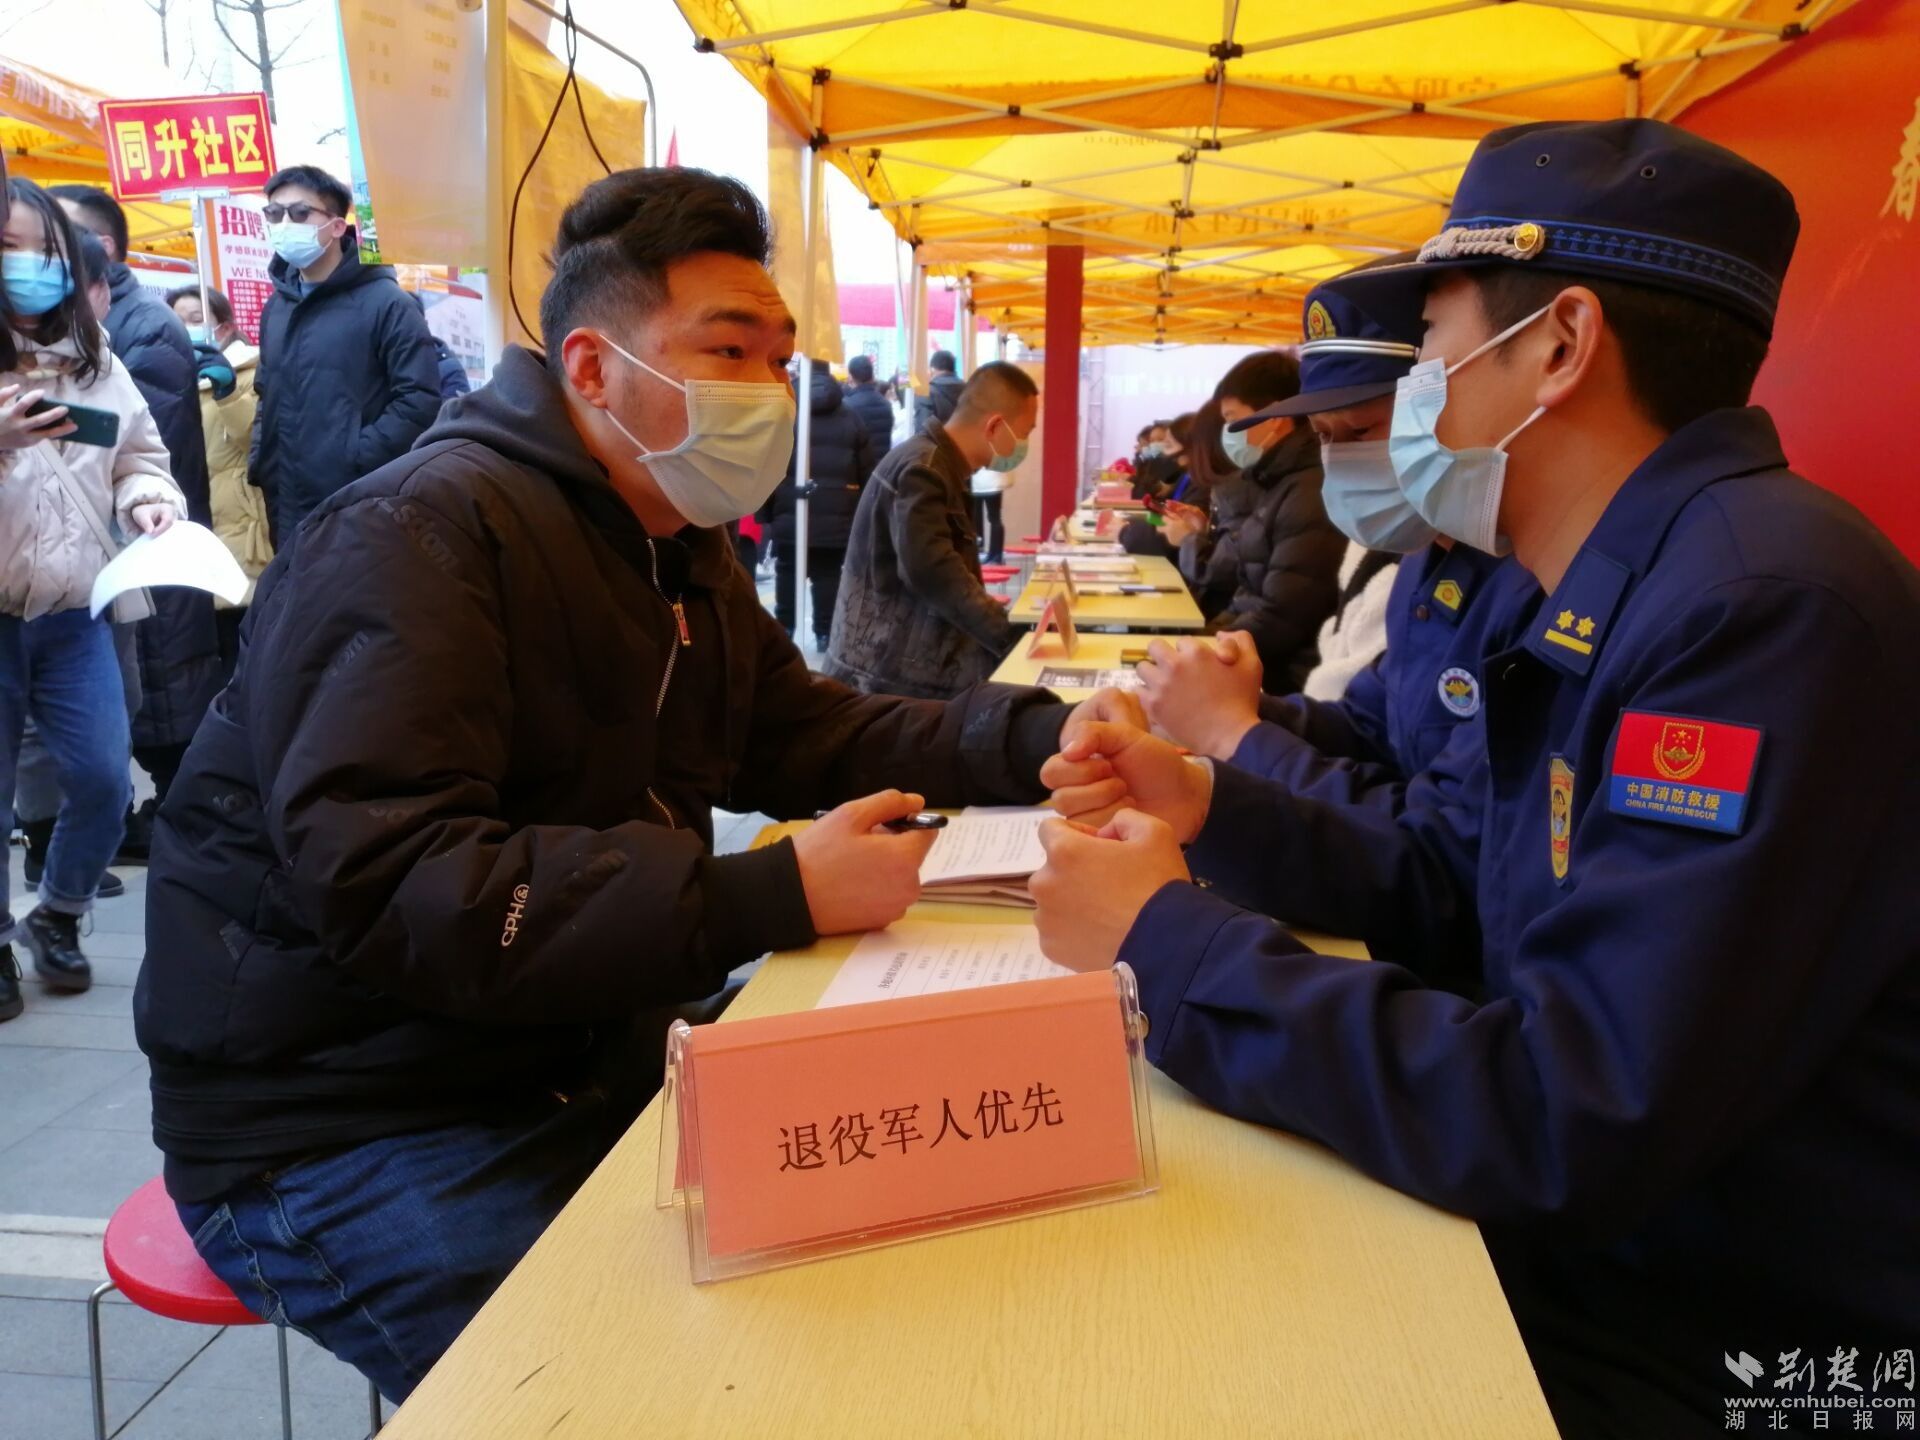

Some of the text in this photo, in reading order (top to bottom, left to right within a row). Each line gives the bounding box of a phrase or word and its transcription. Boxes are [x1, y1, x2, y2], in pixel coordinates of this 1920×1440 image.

[115, 114, 265, 182] 同升社区
[219, 204, 267, 241] 招聘
[231, 266, 252, 278] WE
[1625, 798, 1718, 821] CHINA FIRE AND RESCUE
[1627, 782, 1721, 812] 中国消防救援
[777, 1082, 1065, 1172] 退役军人优先
